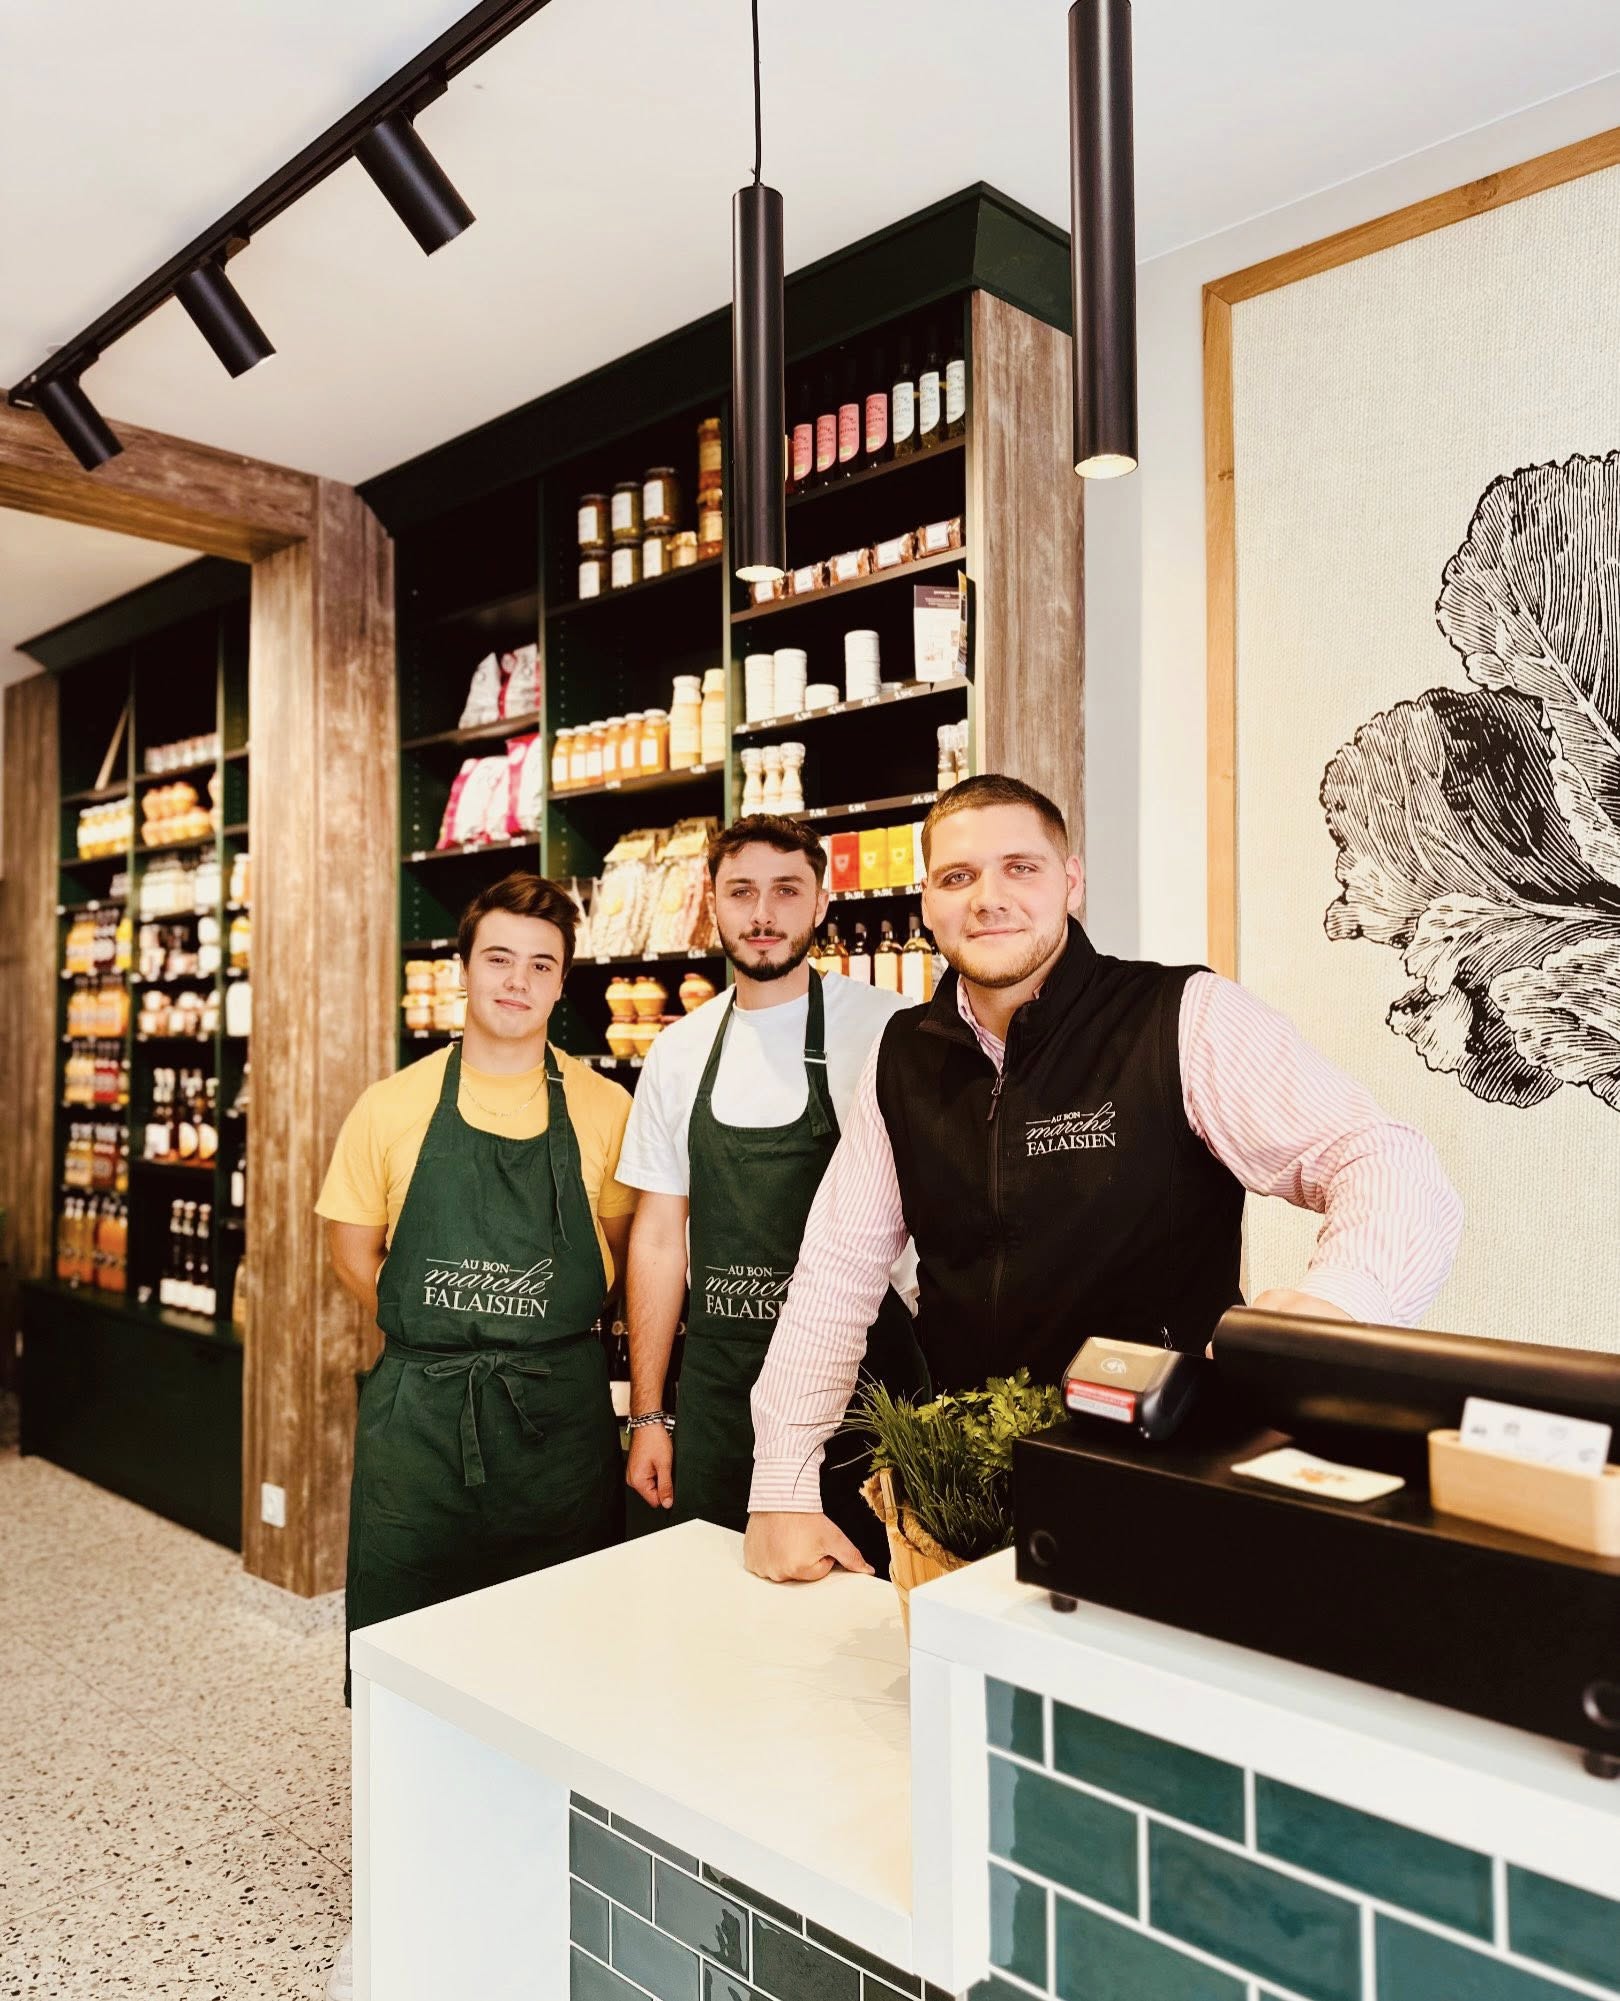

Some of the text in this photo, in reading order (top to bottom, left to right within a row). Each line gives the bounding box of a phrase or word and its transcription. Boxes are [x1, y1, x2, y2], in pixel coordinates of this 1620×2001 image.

[1026, 1101, 1116, 1140] marché
[1051, 1111, 1081, 1123] AU BON
[1026, 1132, 1116, 1157] FALAISIEN
[424, 1258, 554, 1296] marché
[460, 1258, 511, 1274] AU BON
[728, 1265, 773, 1278] AU BON
[423, 1286, 549, 1319] FALAISIEN
